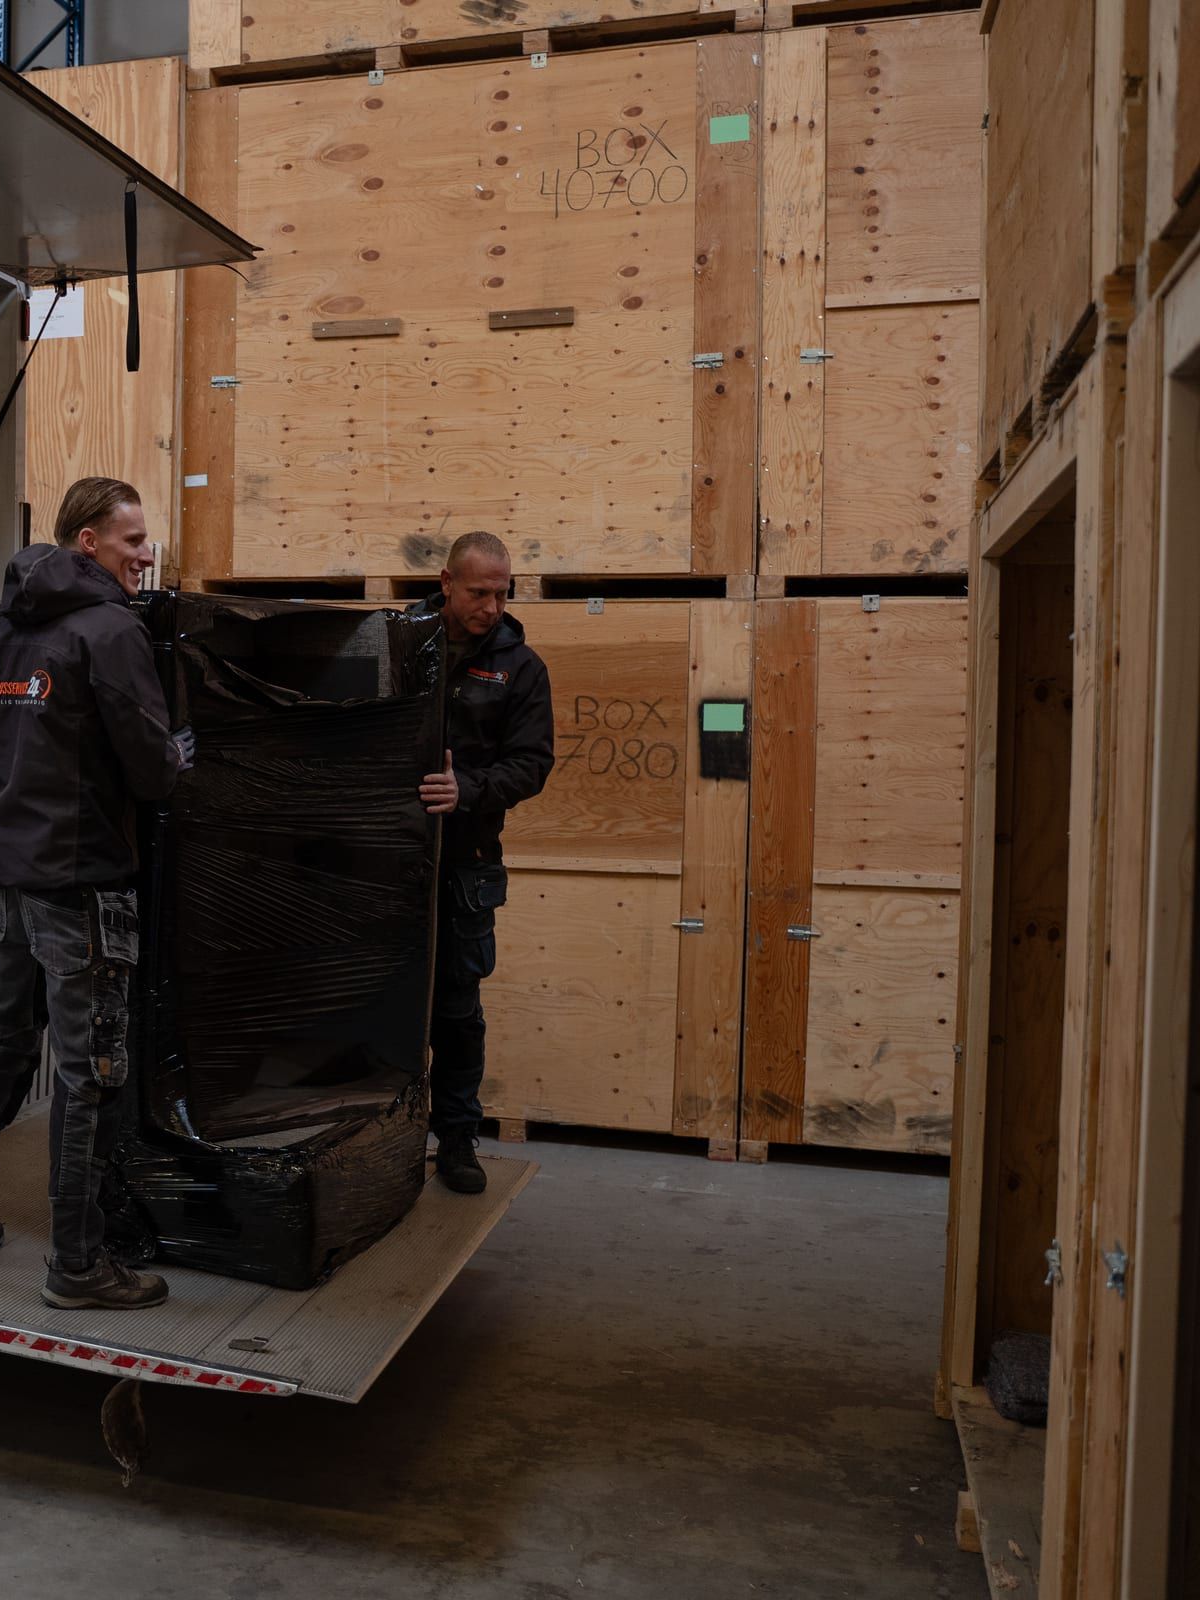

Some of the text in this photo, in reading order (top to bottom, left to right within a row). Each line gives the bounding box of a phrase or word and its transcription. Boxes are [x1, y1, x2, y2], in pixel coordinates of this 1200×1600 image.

[576, 120, 678, 169] BOX
[540, 165, 688, 219] 40700
[575, 696, 668, 731] BOX
[557, 734, 679, 780] 7080
